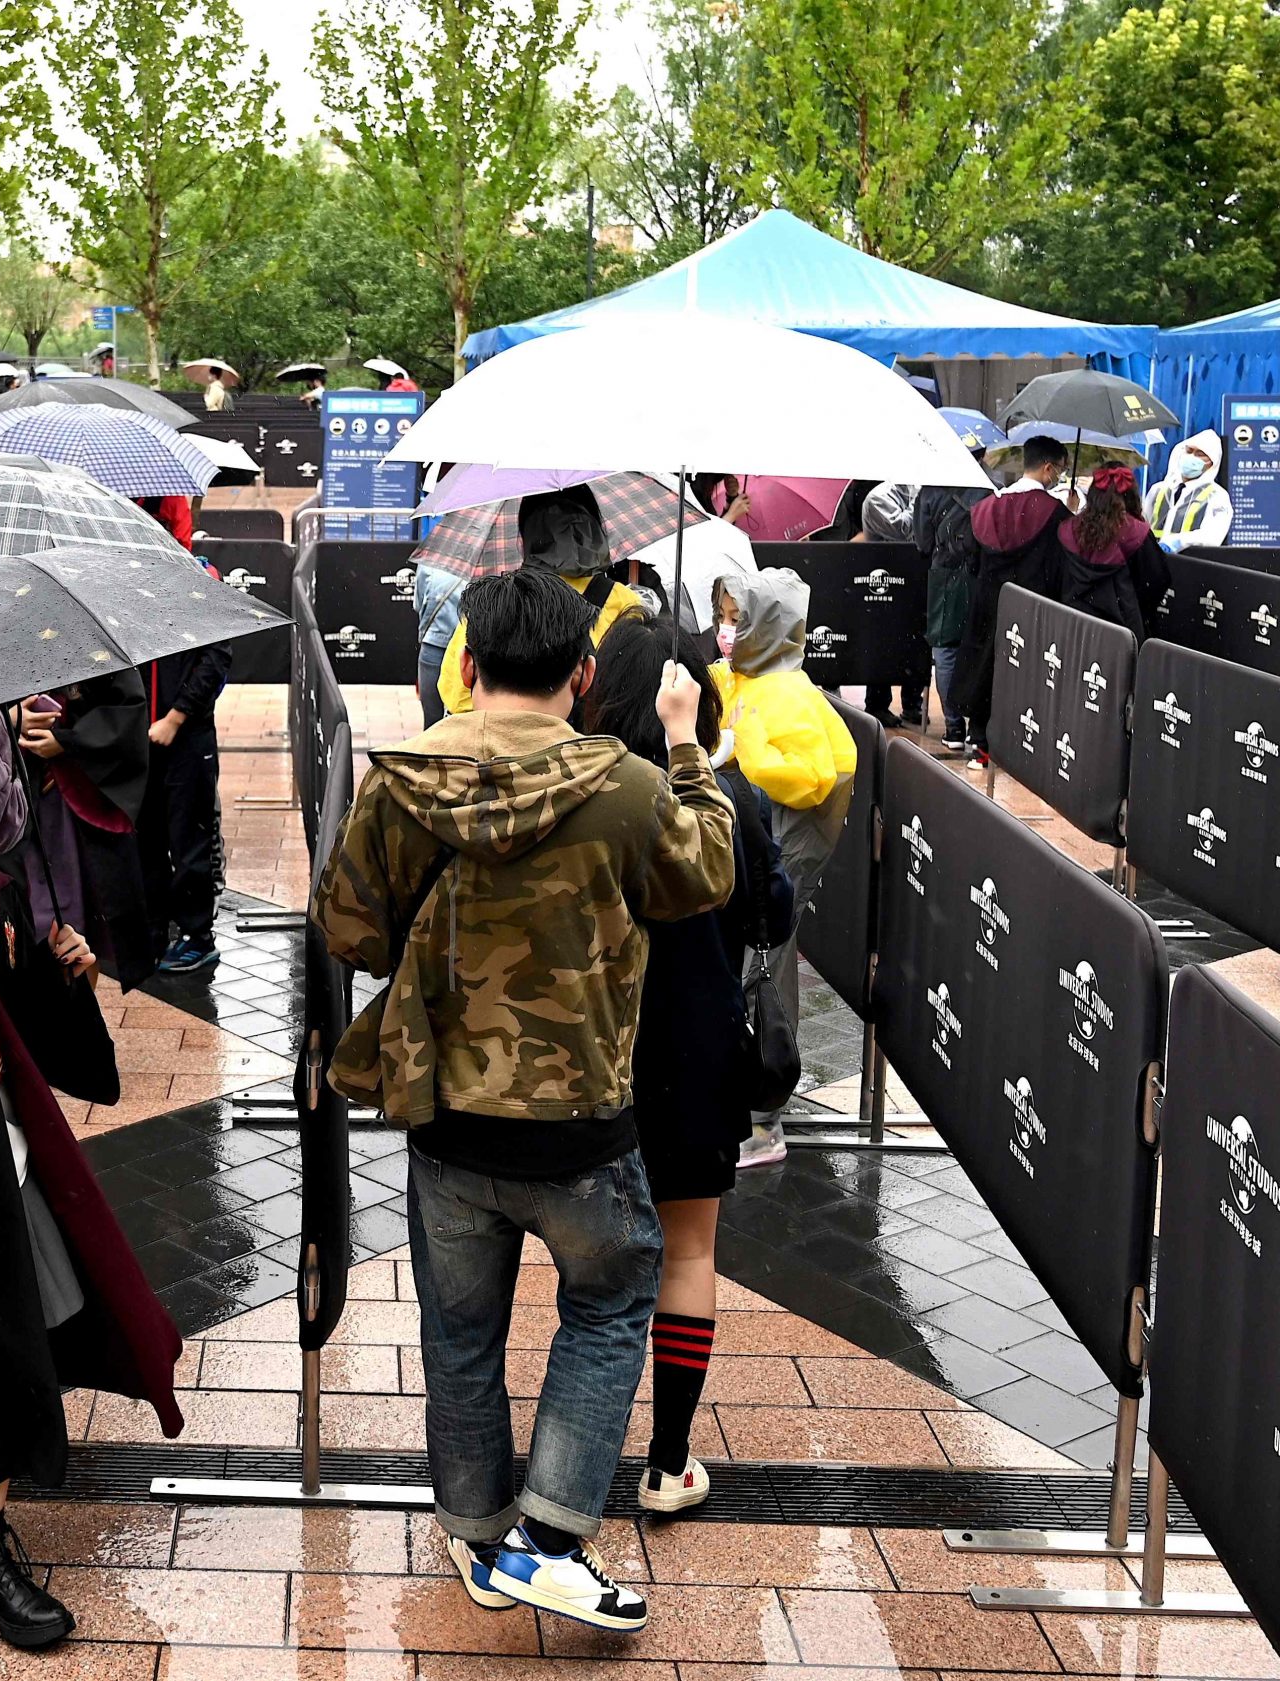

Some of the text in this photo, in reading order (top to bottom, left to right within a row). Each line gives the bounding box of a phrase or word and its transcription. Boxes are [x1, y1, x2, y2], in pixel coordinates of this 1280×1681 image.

[970, 885, 1010, 935] UNIVERSAL STUDIOS
[1059, 967, 1114, 1030] UNIVERSAL STUDIOS
[1075, 997, 1097, 1023] BEIJING
[1003, 1077, 1047, 1144] UNIVERSAL STUDIOS
[1206, 1115, 1248, 1173] UNIVERSAL
[1229, 1157, 1257, 1197] BEIJING
[1220, 1198, 1261, 1258] 北京环球影城
